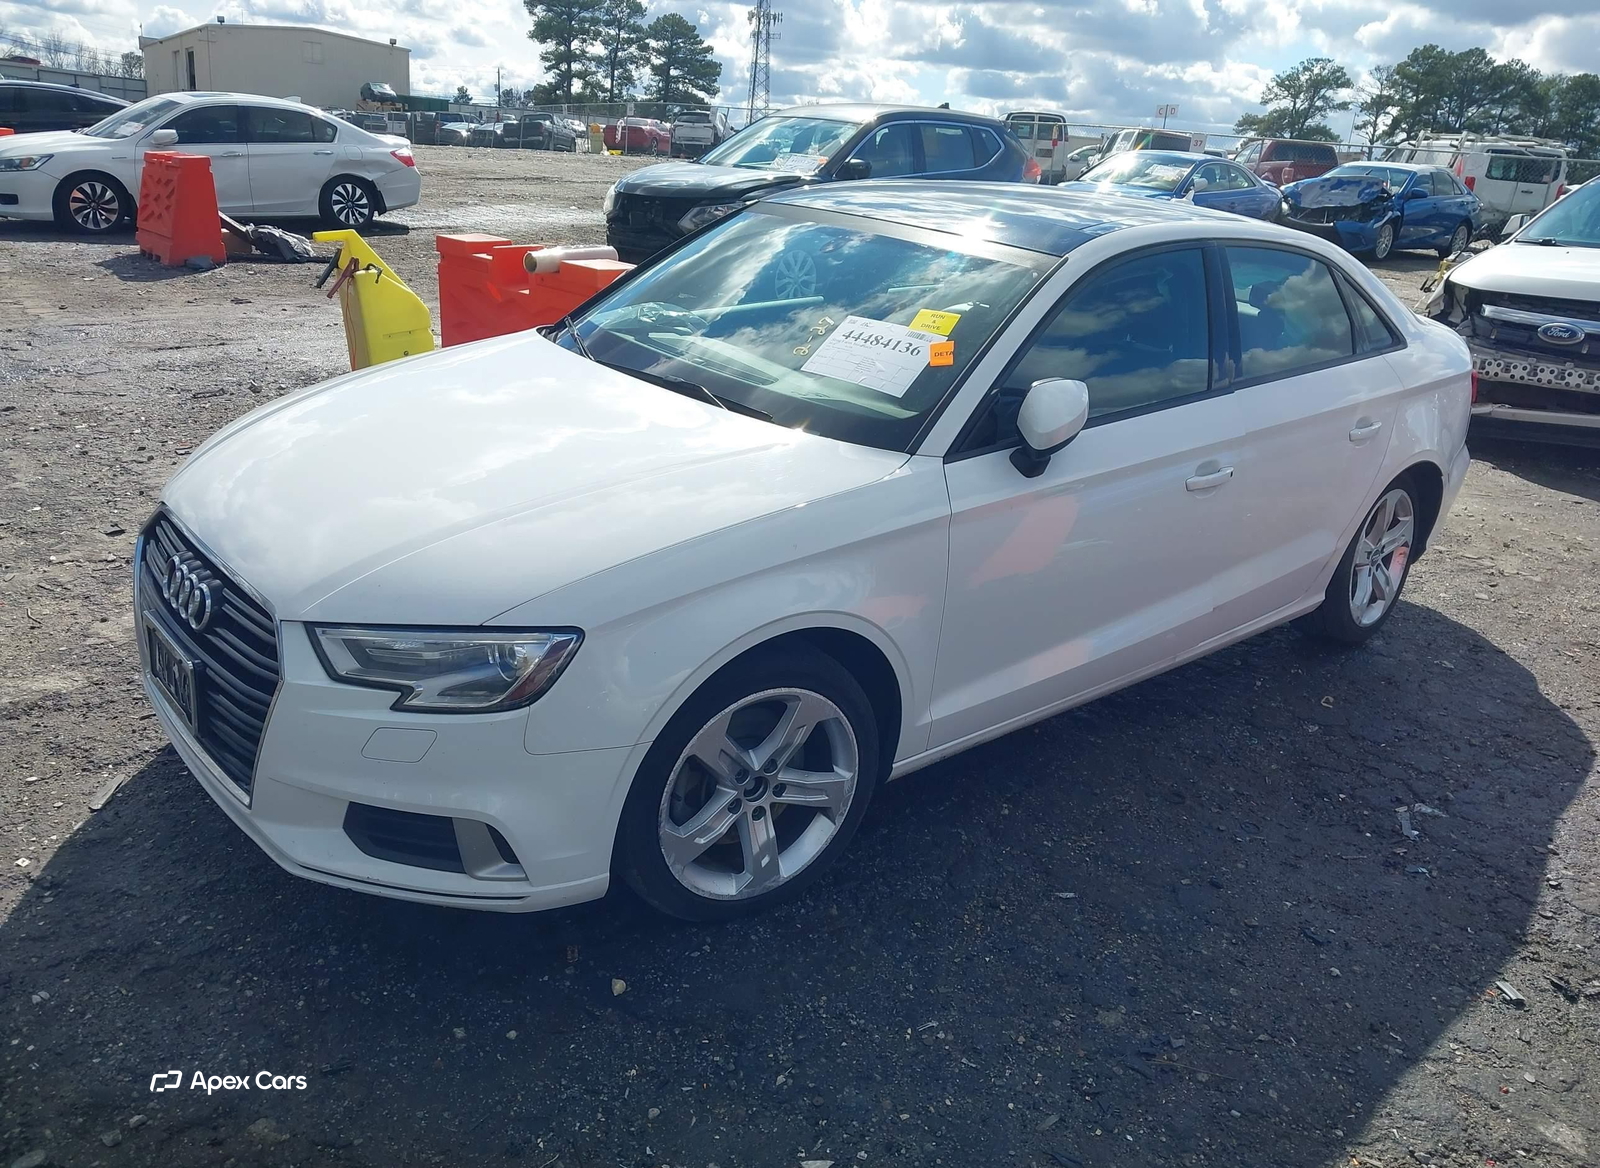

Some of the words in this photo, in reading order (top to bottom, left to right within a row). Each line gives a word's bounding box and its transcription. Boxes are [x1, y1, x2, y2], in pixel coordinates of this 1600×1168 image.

[1158, 107, 1164, 115] C
[1170, 107, 1176, 115] D
[1193, 139, 1203, 147] 37
[920, 323, 941, 331] DRIVE
[1547, 326, 1571, 338] Ford
[842, 329, 926, 357] 44484136
